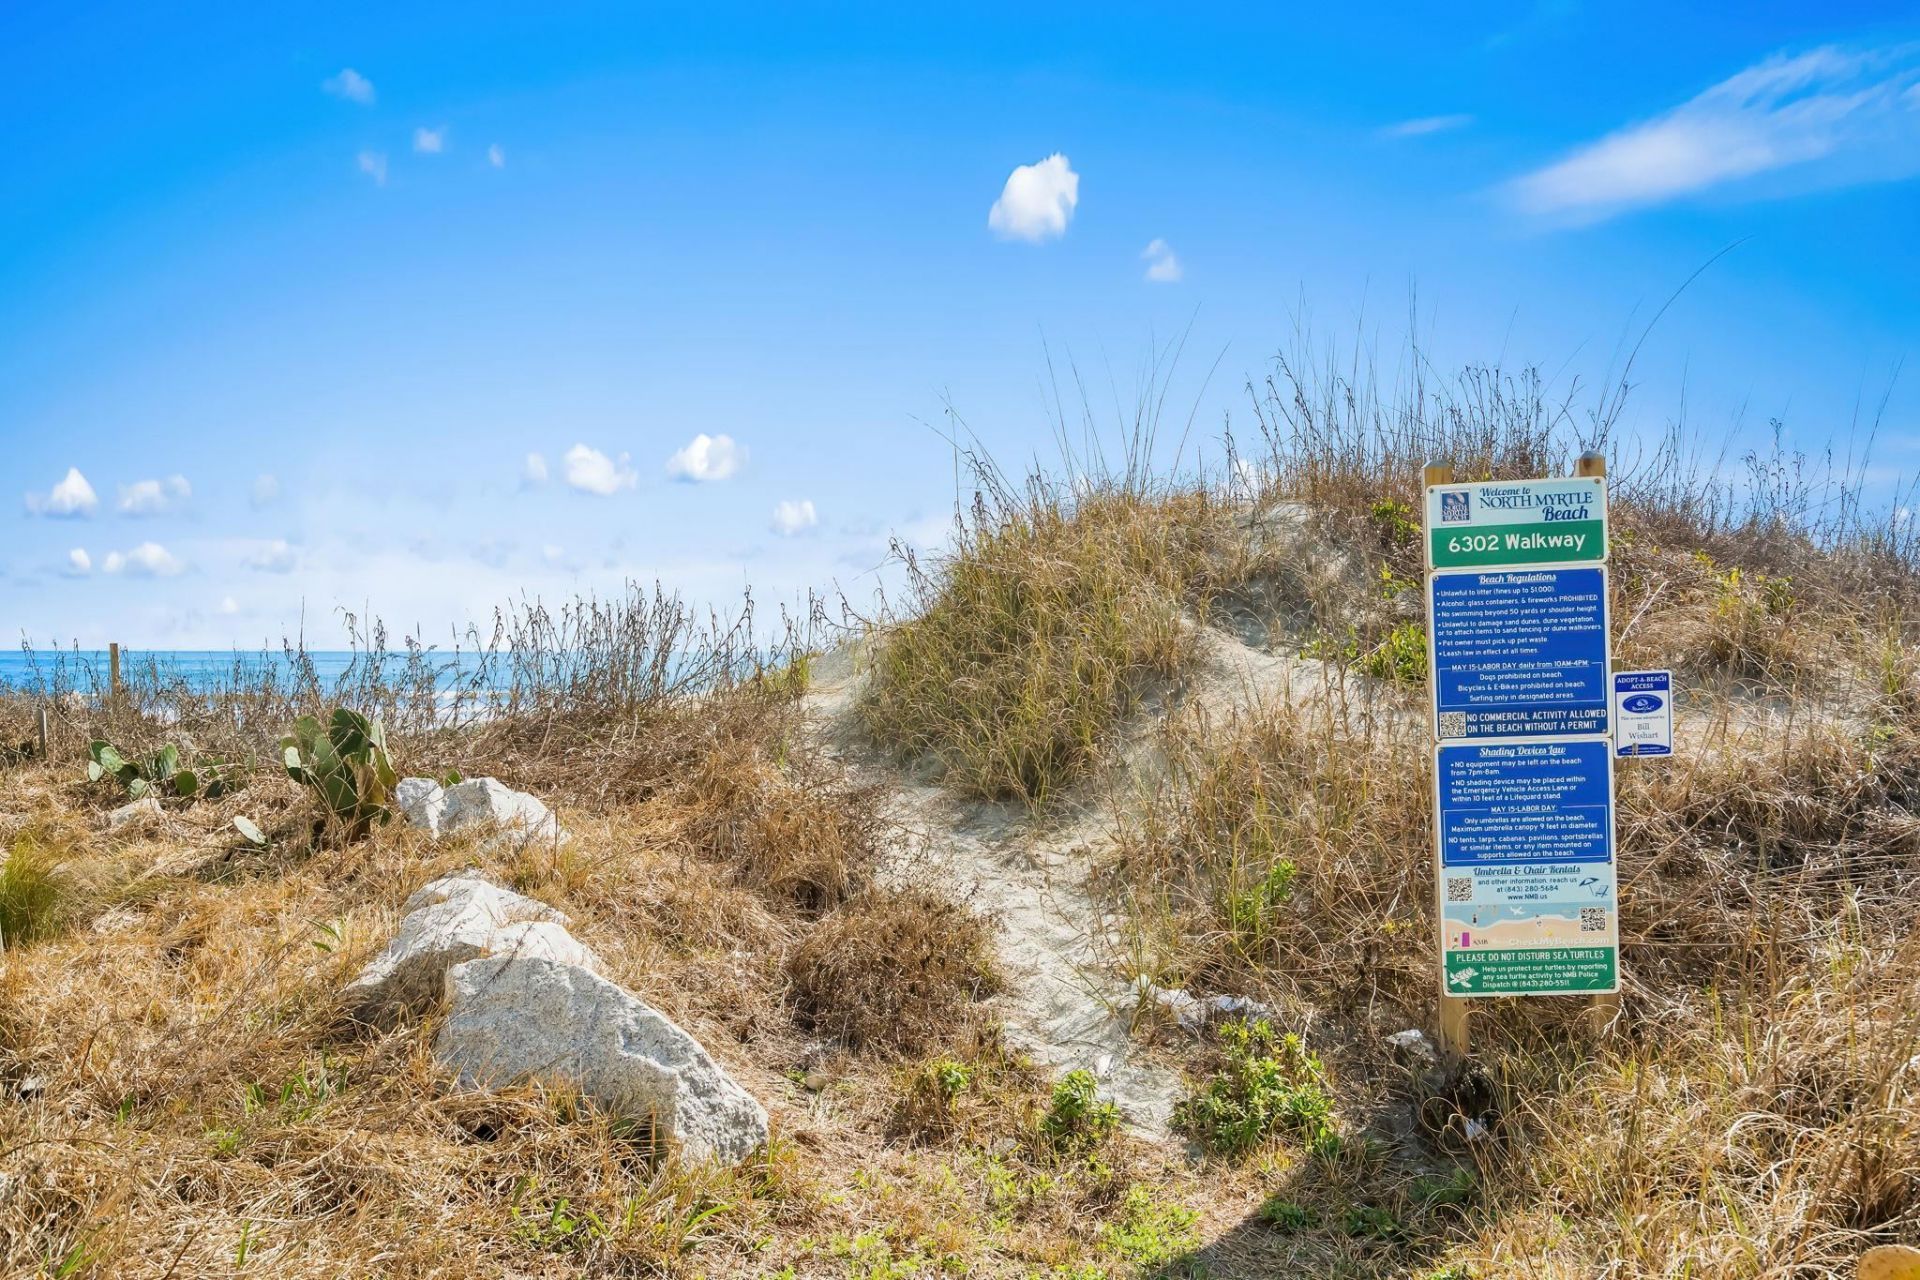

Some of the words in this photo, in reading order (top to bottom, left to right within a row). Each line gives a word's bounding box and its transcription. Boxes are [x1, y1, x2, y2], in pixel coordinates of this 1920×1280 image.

[1480, 488, 1520, 496] Welcome
[1480, 495, 1531, 508] NORTH
[1536, 492, 1593, 507] MYRTLE
[1542, 505, 1588, 521] Beach
[1449, 535, 1499, 552] 6302
[1505, 533, 1585, 552] Walkway
[1479, 575, 1504, 584] Beach
[1506, 573, 1556, 584] Regulations
[1498, 672, 1530, 680] prohibited
[1480, 712, 1529, 721] COMMERCIAL
[1533, 711, 1567, 720] ACTIVITY
[1570, 710, 1606, 718] ALLOWED
[1468, 725, 1478, 733] ON
[1481, 724, 1494, 732] THE
[1497, 723, 1522, 732] BEACH
[1525, 722, 1557, 731] WITHOUT
[1568, 721, 1597, 729] PERMIT
[1480, 747, 1515, 757] Shading
[1517, 746, 1546, 754] Devices
[1548, 745, 1566, 755] Law
[1474, 868, 1511, 876] Umbrella
[1524, 866, 1547, 875] Chair
[1549, 866, 1580, 874] Rentals
[1456, 953, 1486, 962] PLEASE
[1518, 952, 1550, 960] DISTURB
[1570, 950, 1604, 959] TURTLES
